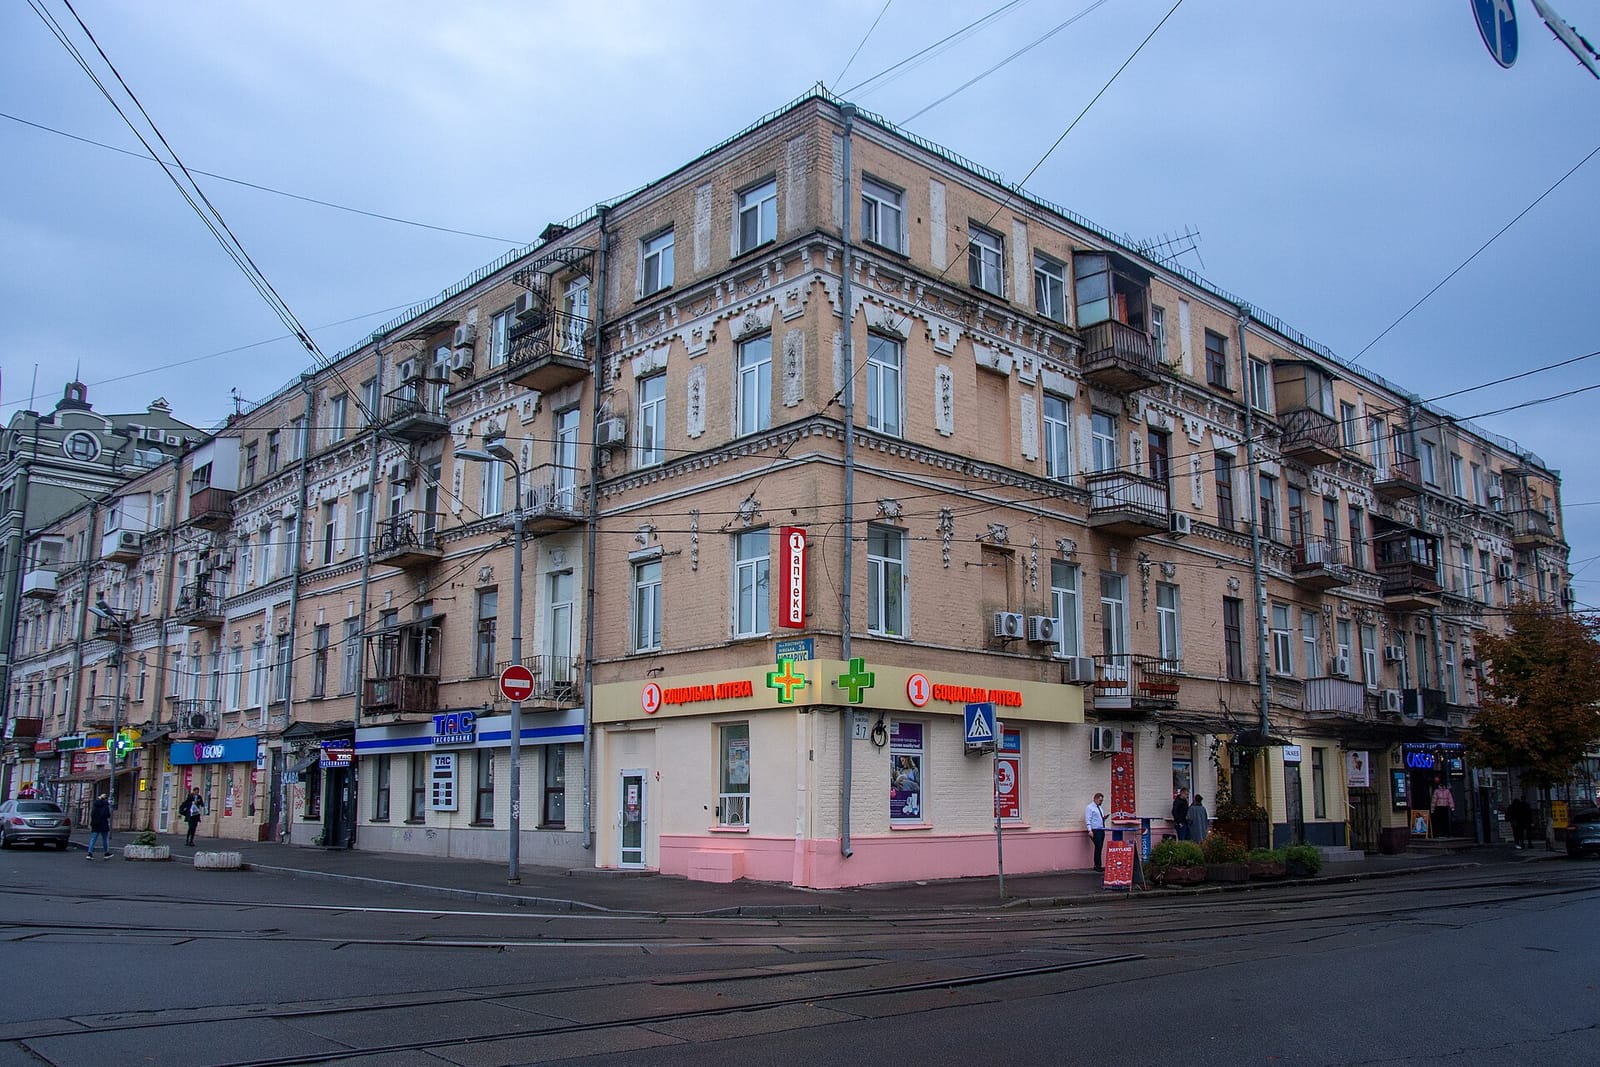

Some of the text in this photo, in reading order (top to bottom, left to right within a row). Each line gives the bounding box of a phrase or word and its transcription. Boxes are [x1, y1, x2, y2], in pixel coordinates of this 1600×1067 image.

[793, 536, 800, 548] 1
[646, 688, 655, 707] 1
[716, 680, 753, 700] АПТЕКА
[914, 680, 924, 699] 1
[988, 689, 1023, 707] АПТЕКА
[431, 711, 474, 735] ТАС
[433, 734, 471, 743] ТАСКОМБАНК
[855, 724, 866, 739] 37
[435, 756, 451, 765] ТАС
